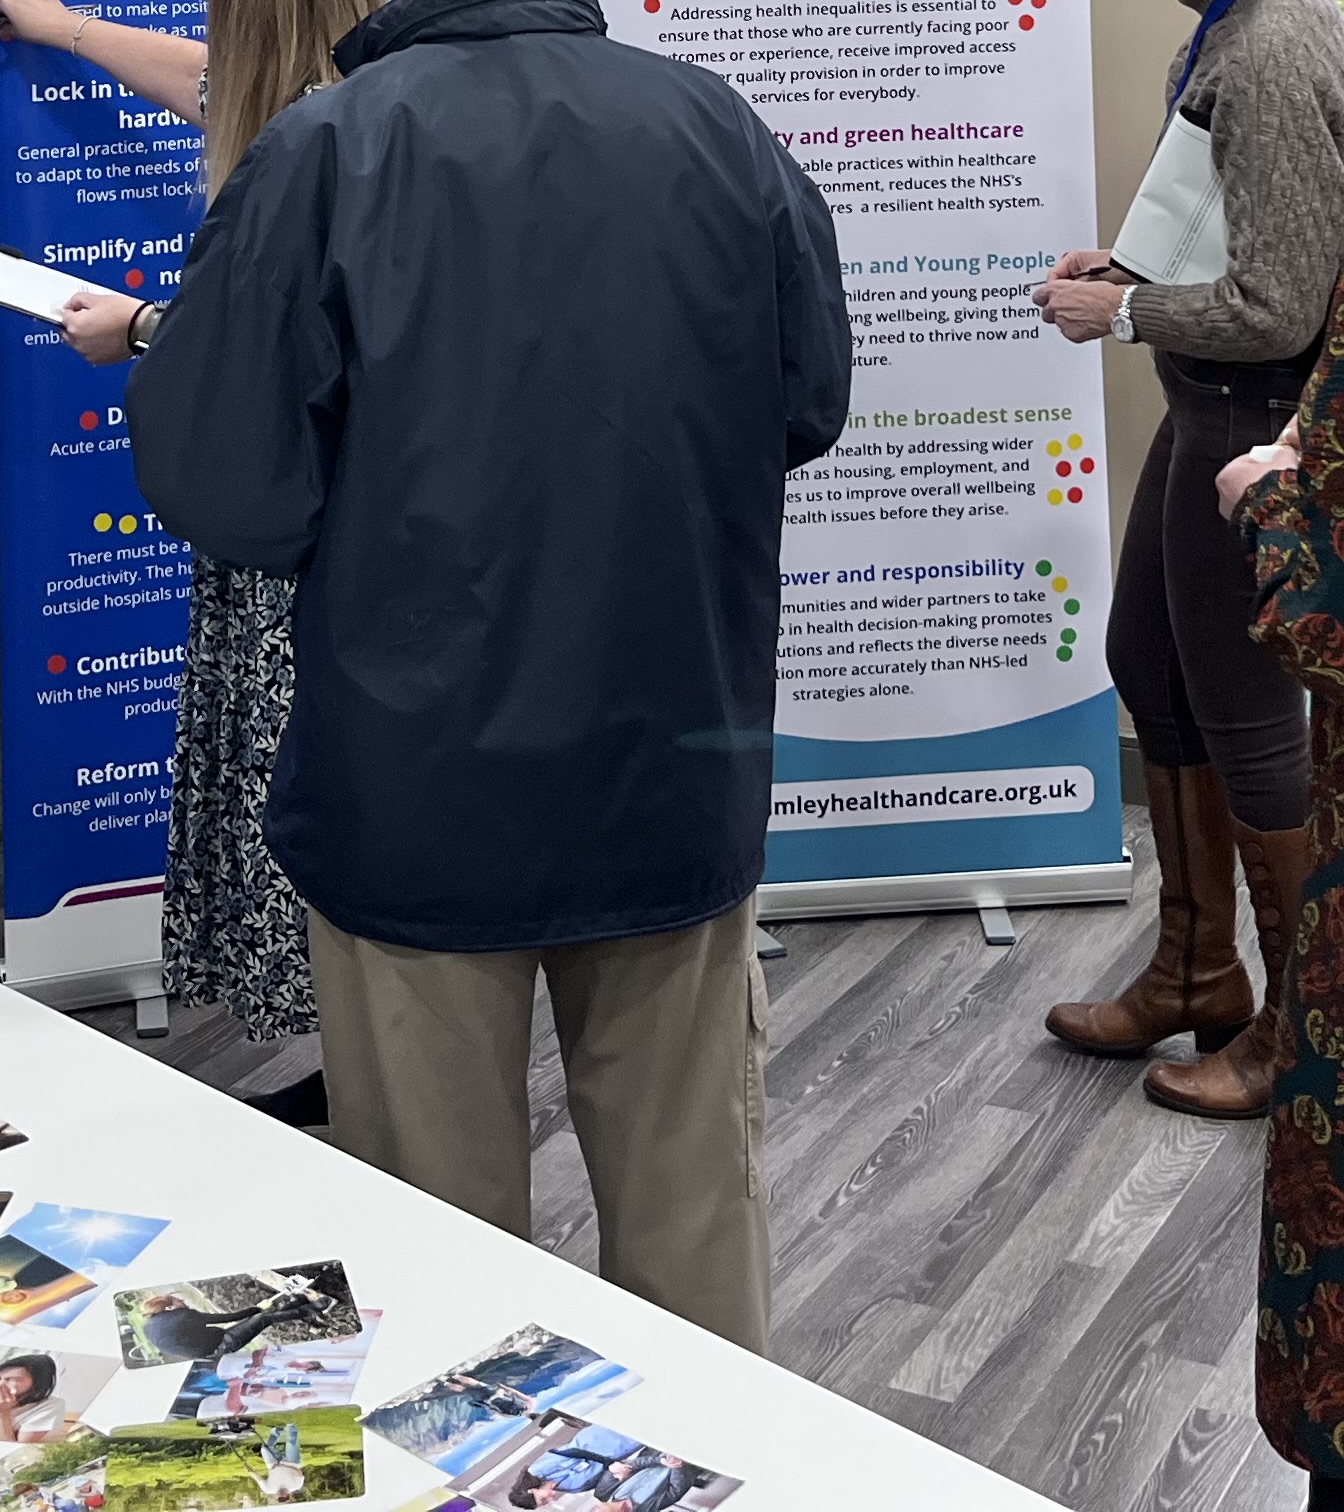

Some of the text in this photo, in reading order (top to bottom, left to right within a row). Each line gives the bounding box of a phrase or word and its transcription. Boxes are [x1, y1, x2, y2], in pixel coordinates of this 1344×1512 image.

[31, 79, 112, 103] Lock in
[799, 122, 1024, 148] and green healthcare
[17, 142, 80, 161] General
[84, 141, 149, 161] practice,
[42, 233, 183, 266] Simplify and
[869, 250, 1057, 276] and Young People
[847, 406, 1072, 429] in the broadest sense
[67, 540, 179, 567] There must be
[836, 558, 1025, 585] and responsibility
[792, 682, 915, 702] strategies alone.
[77, 761, 159, 787] Reform
[32, 787, 158, 818] Change will only
